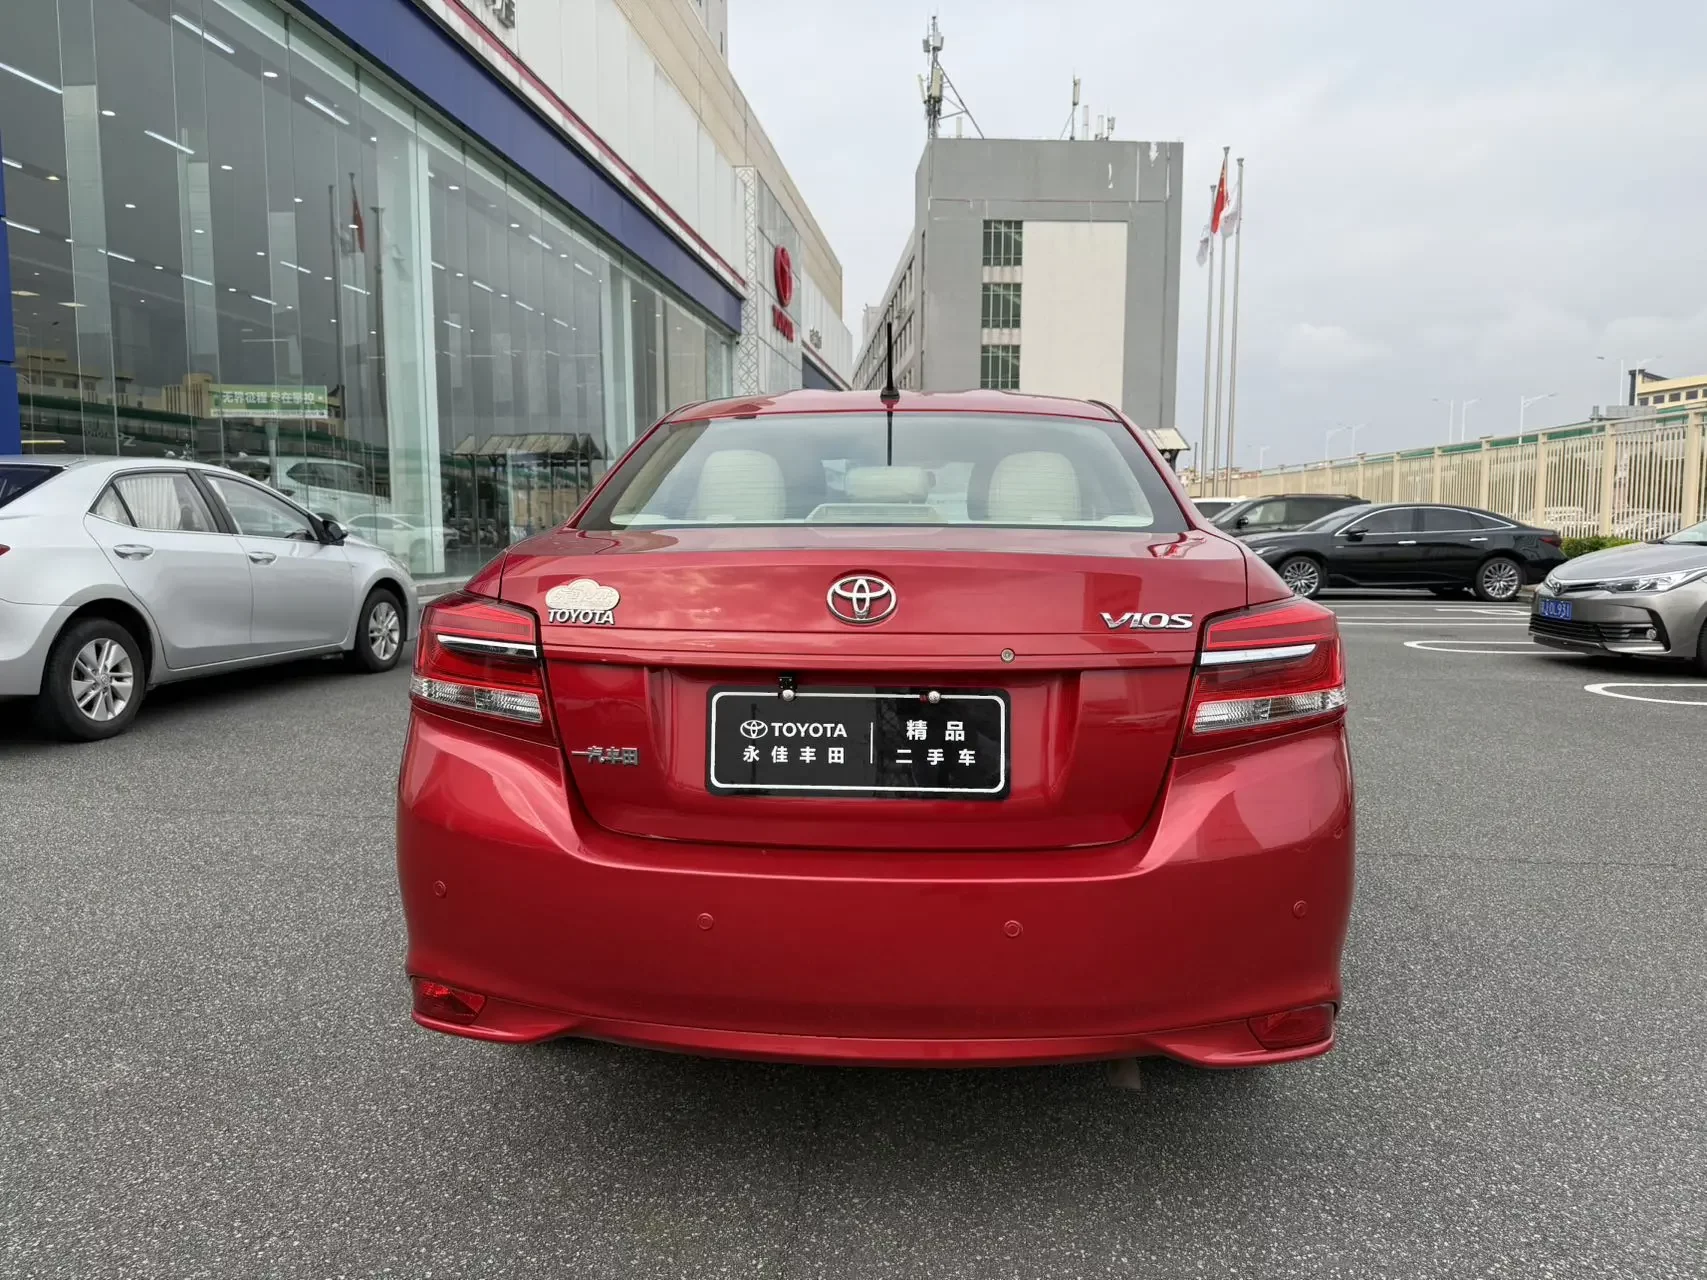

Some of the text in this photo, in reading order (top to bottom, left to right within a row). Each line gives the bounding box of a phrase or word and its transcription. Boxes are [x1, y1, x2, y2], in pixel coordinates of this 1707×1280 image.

[548, 609, 615, 625] TOYOTA
[1100, 612, 1194, 629] VIOS
[771, 722, 848, 739] TOYOTA
[906, 719, 966, 742] 精品
[571, 745, 639, 766] 一汽丰田
[742, 746, 845, 764] 永佳丰田
[895, 749, 977, 767] 二手车
